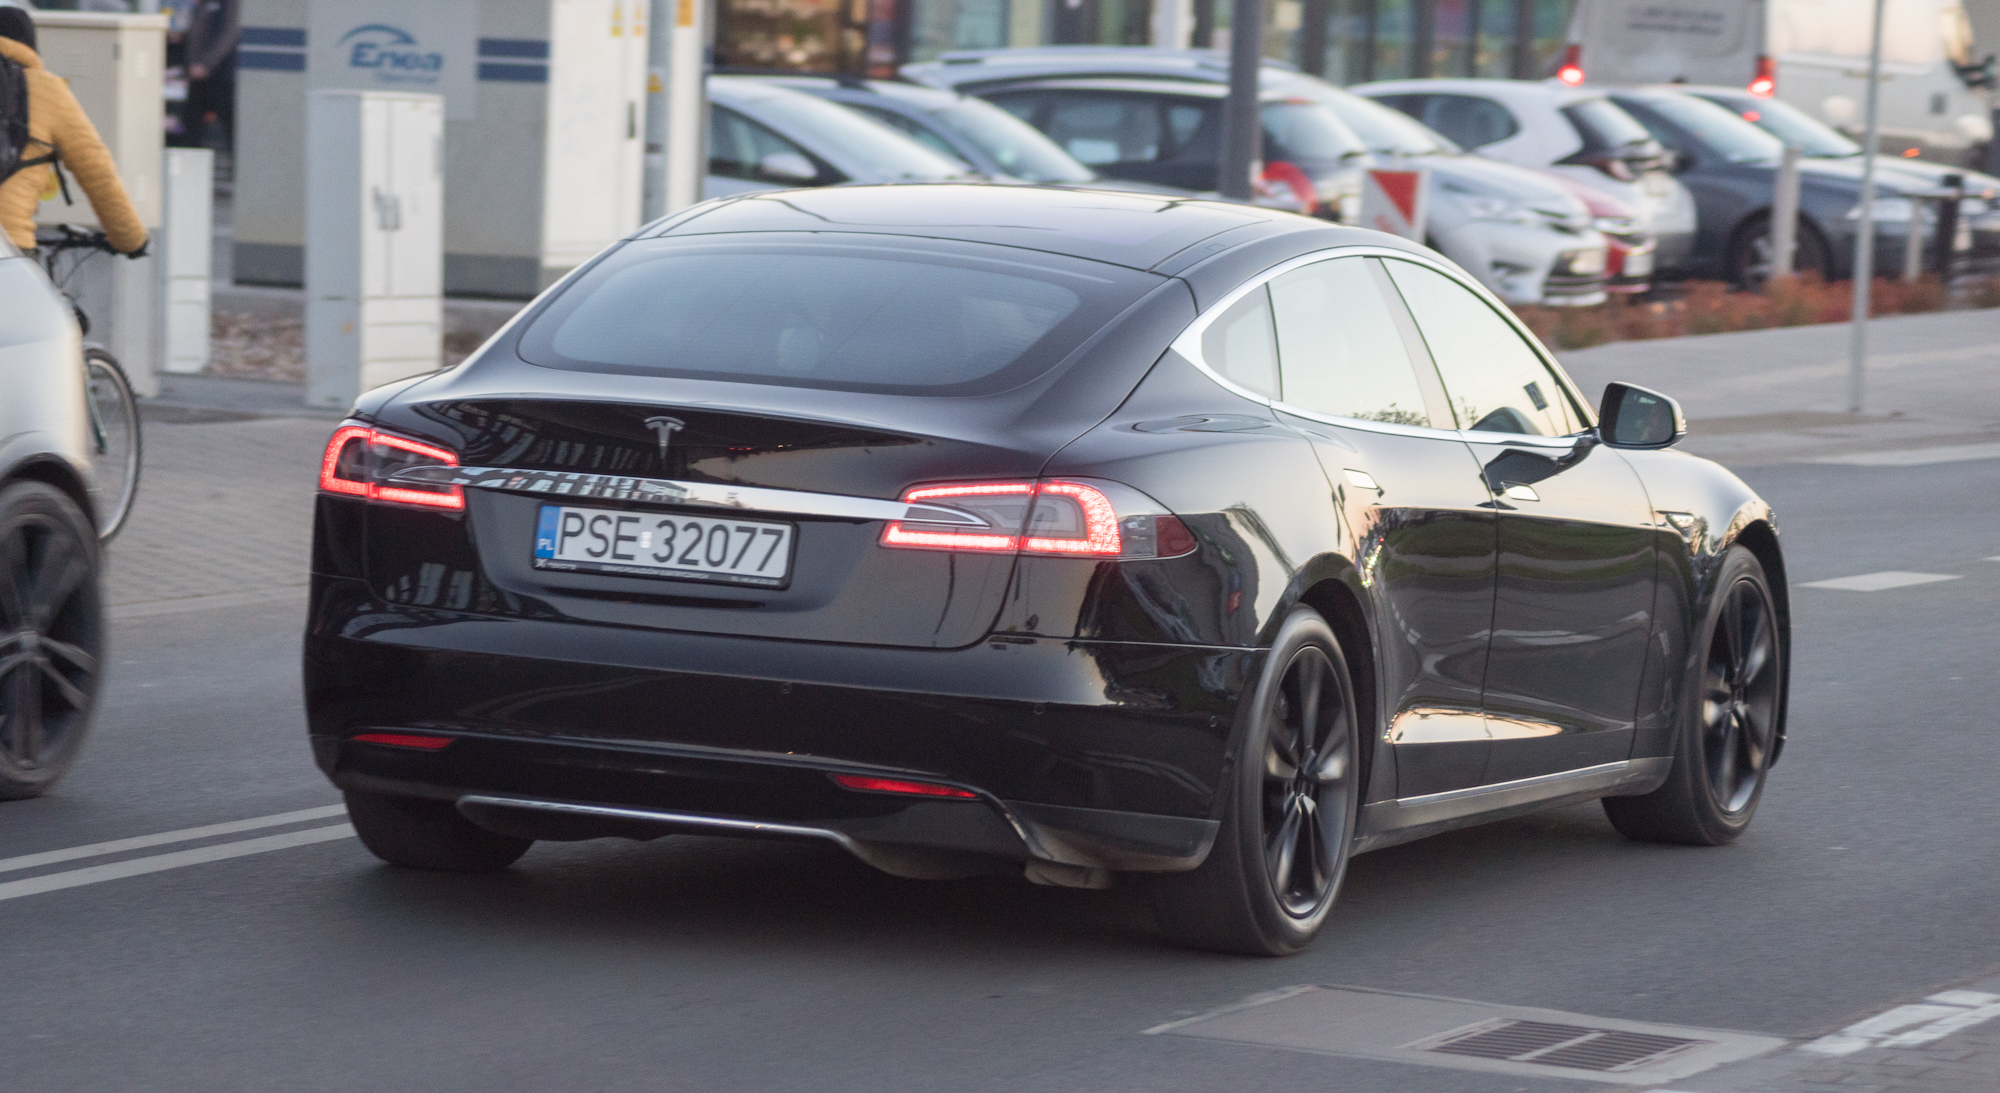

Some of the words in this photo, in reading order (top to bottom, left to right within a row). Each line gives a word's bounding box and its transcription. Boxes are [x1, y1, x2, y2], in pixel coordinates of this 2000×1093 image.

[349, 41, 443, 71] Enea
[537, 538, 554, 551] PL
[558, 511, 641, 561] PSE
[652, 519, 785, 572] 32077
